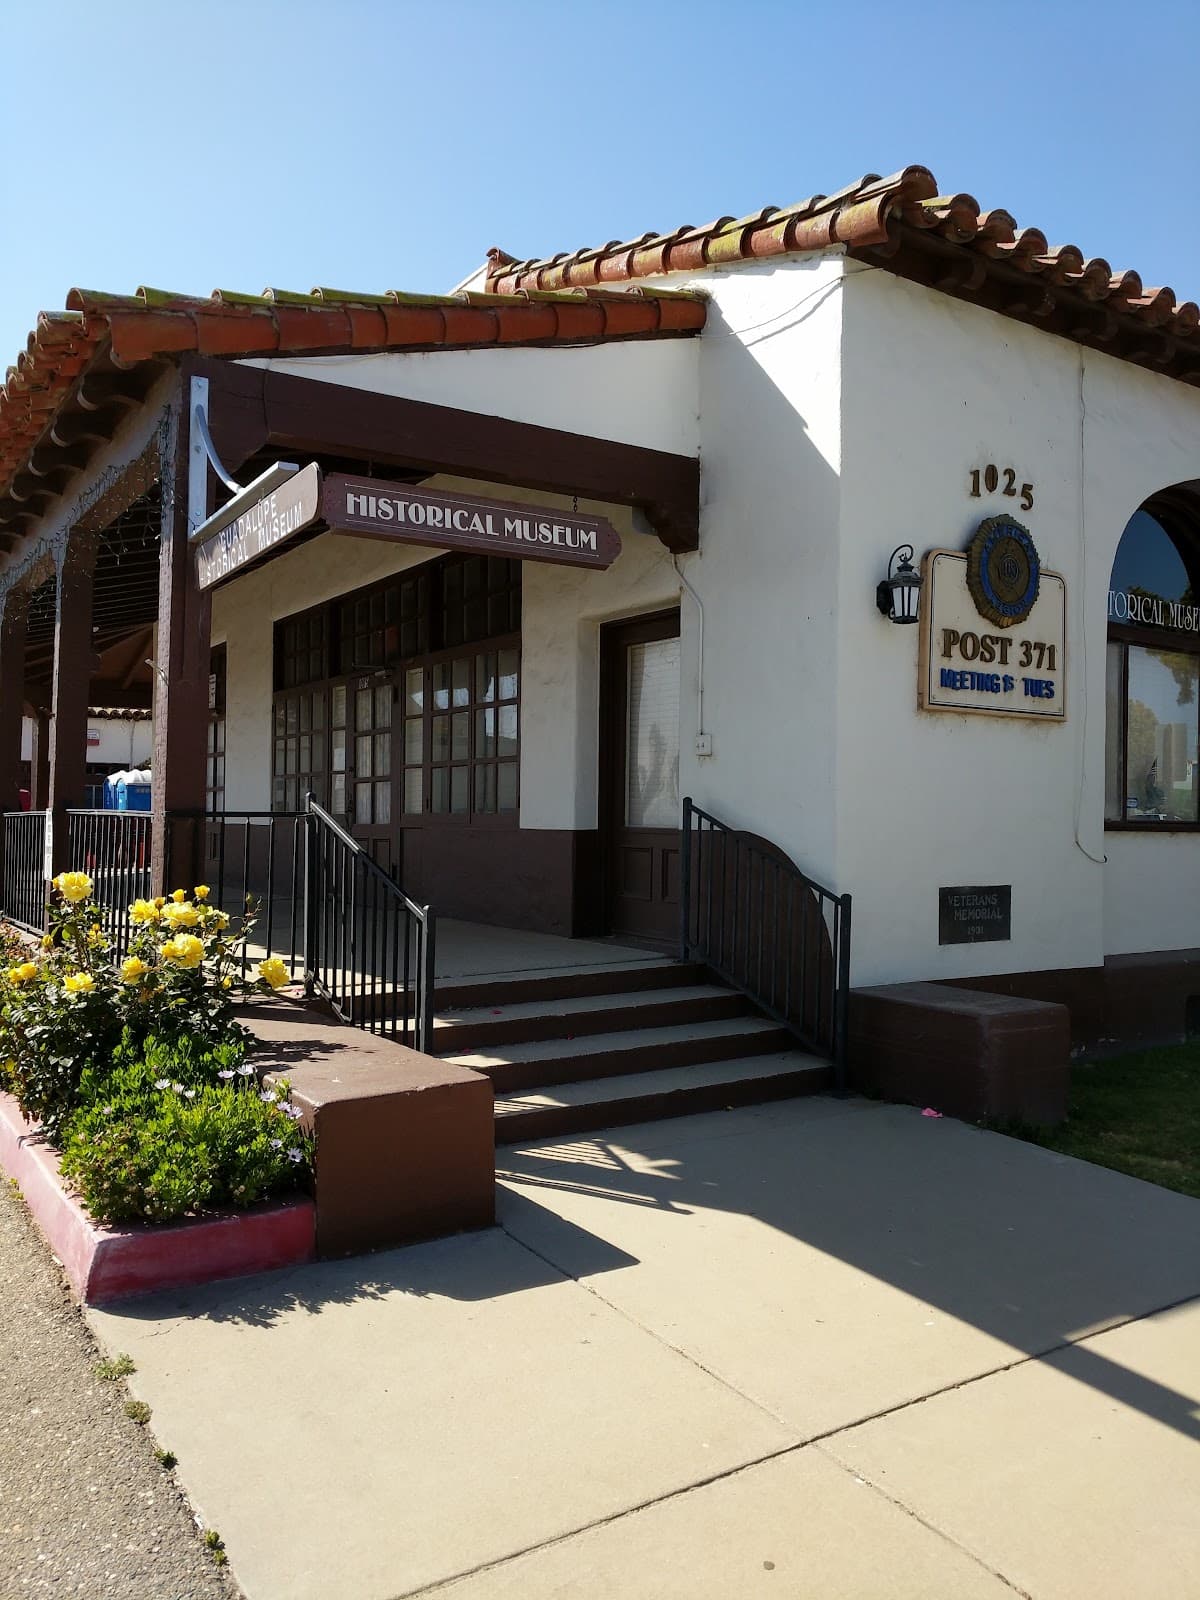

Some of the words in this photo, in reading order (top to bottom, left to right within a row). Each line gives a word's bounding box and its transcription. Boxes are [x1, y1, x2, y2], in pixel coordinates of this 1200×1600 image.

[969, 464, 1034, 511] 1025
[219, 495, 278, 553] GUADALUPE
[257, 501, 303, 553] MUSEUM
[346, 492, 499, 536] HISTORICAL
[504, 517, 597, 551] MUSEUM
[1106, 590, 1164, 626] TORICAL
[1168, 602, 1200, 632] MUSE
[941, 628, 1013, 665] POST
[1019, 640, 1057, 671] 371
[940, 667, 1001, 694] MEETING
[1021, 677, 1056, 699] TUES
[947, 894, 999, 907] VETERANS
[954, 907, 1003, 921] MEMORIAL
